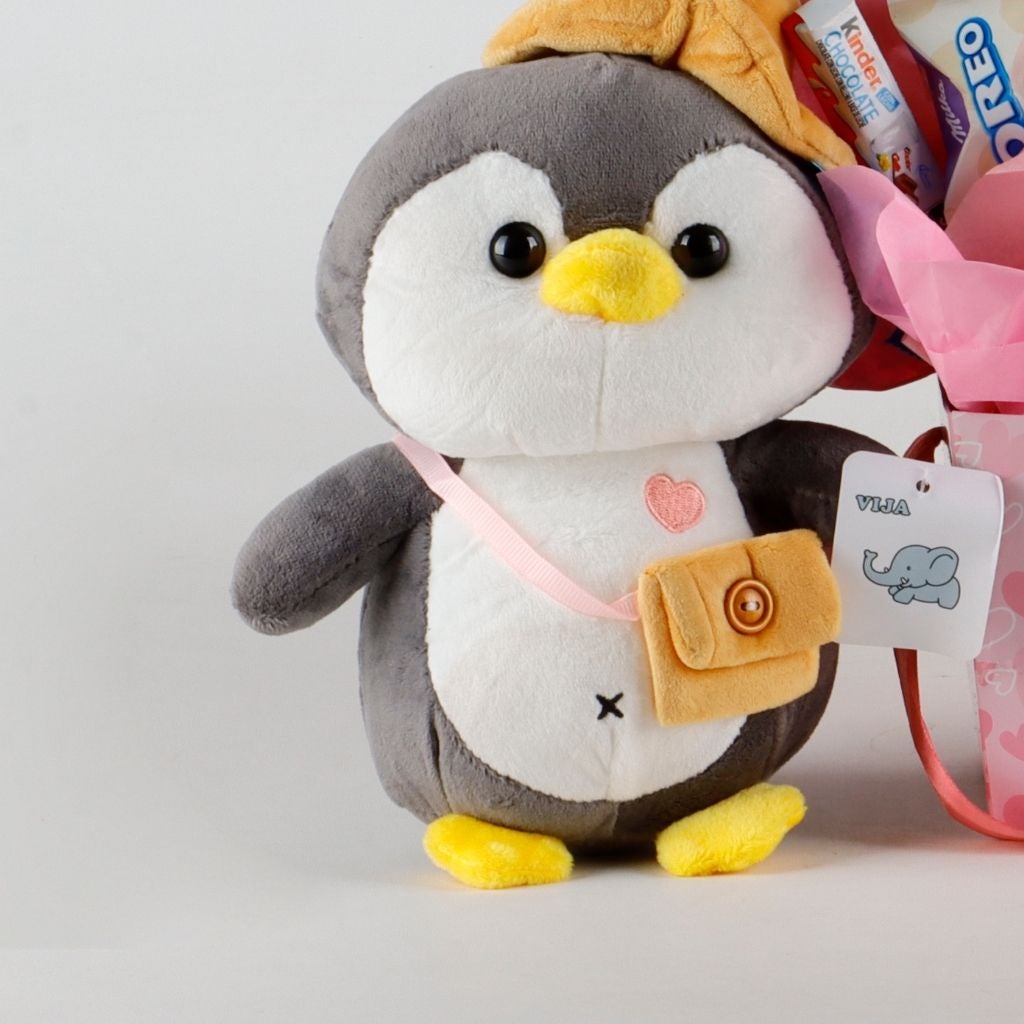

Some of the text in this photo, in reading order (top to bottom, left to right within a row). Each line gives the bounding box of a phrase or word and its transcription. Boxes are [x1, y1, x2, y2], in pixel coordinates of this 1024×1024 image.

[823, 30, 879, 125] CHOCOLATE
[841, 16, 881, 89] Kinder
[855, 494, 911, 516] VIJA
